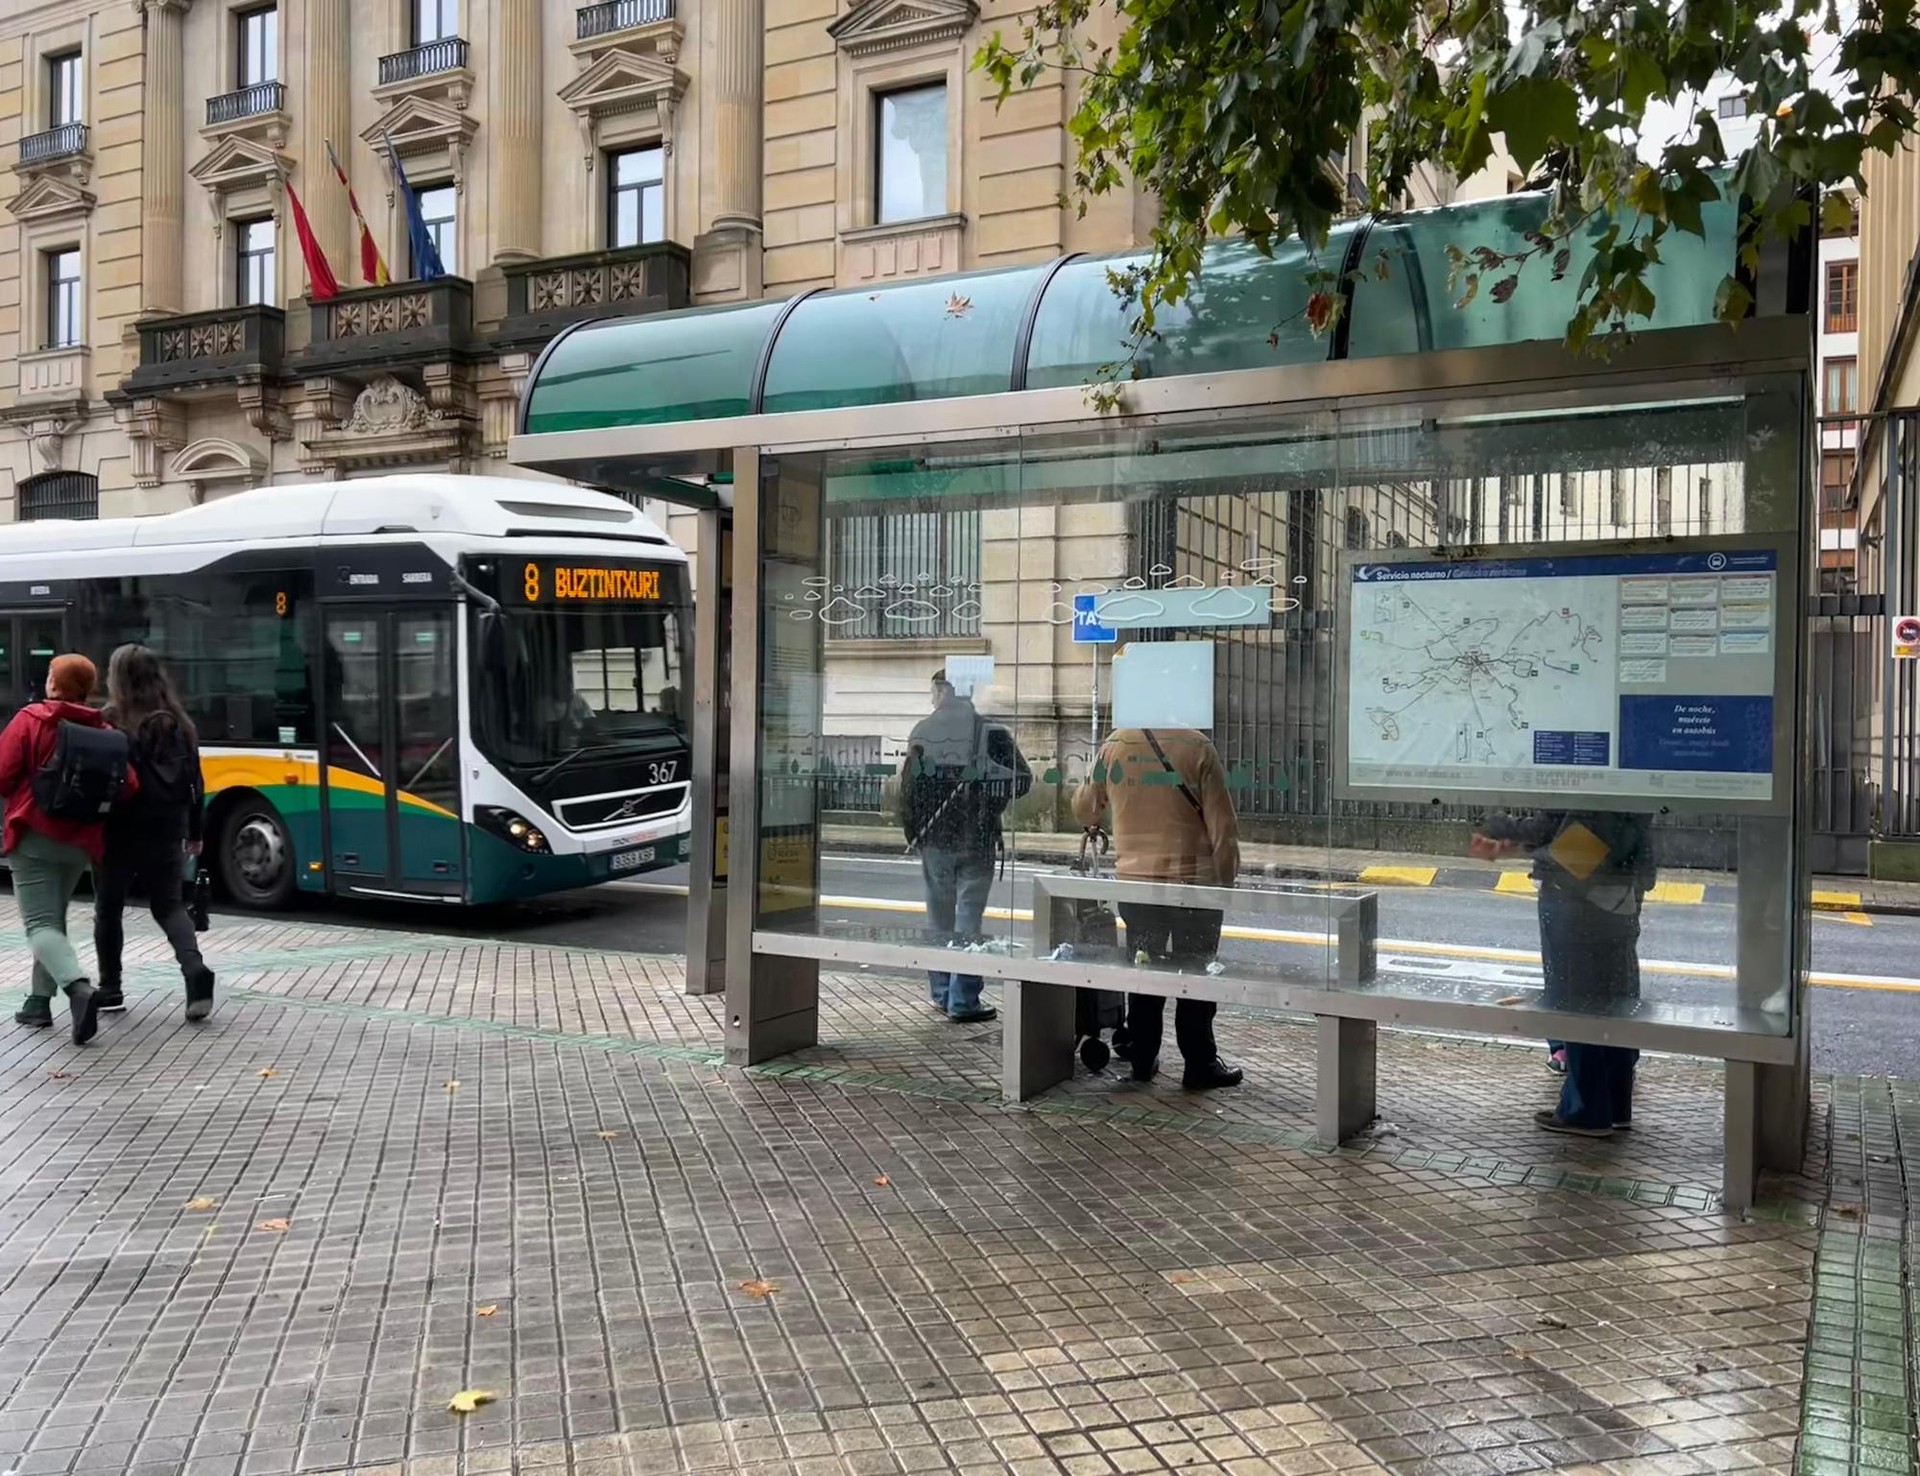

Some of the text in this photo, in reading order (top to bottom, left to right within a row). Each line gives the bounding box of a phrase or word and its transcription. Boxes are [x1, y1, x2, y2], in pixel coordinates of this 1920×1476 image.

[524, 563, 661, 601] 8 BUZTINTXURI
[1376, 571, 1409, 581] Servicio
[1410, 570, 1445, 580] nocturno
[276, 591, 287, 615] 8
[1674, 705, 1686, 713] De
[648, 760, 678, 784] 367
